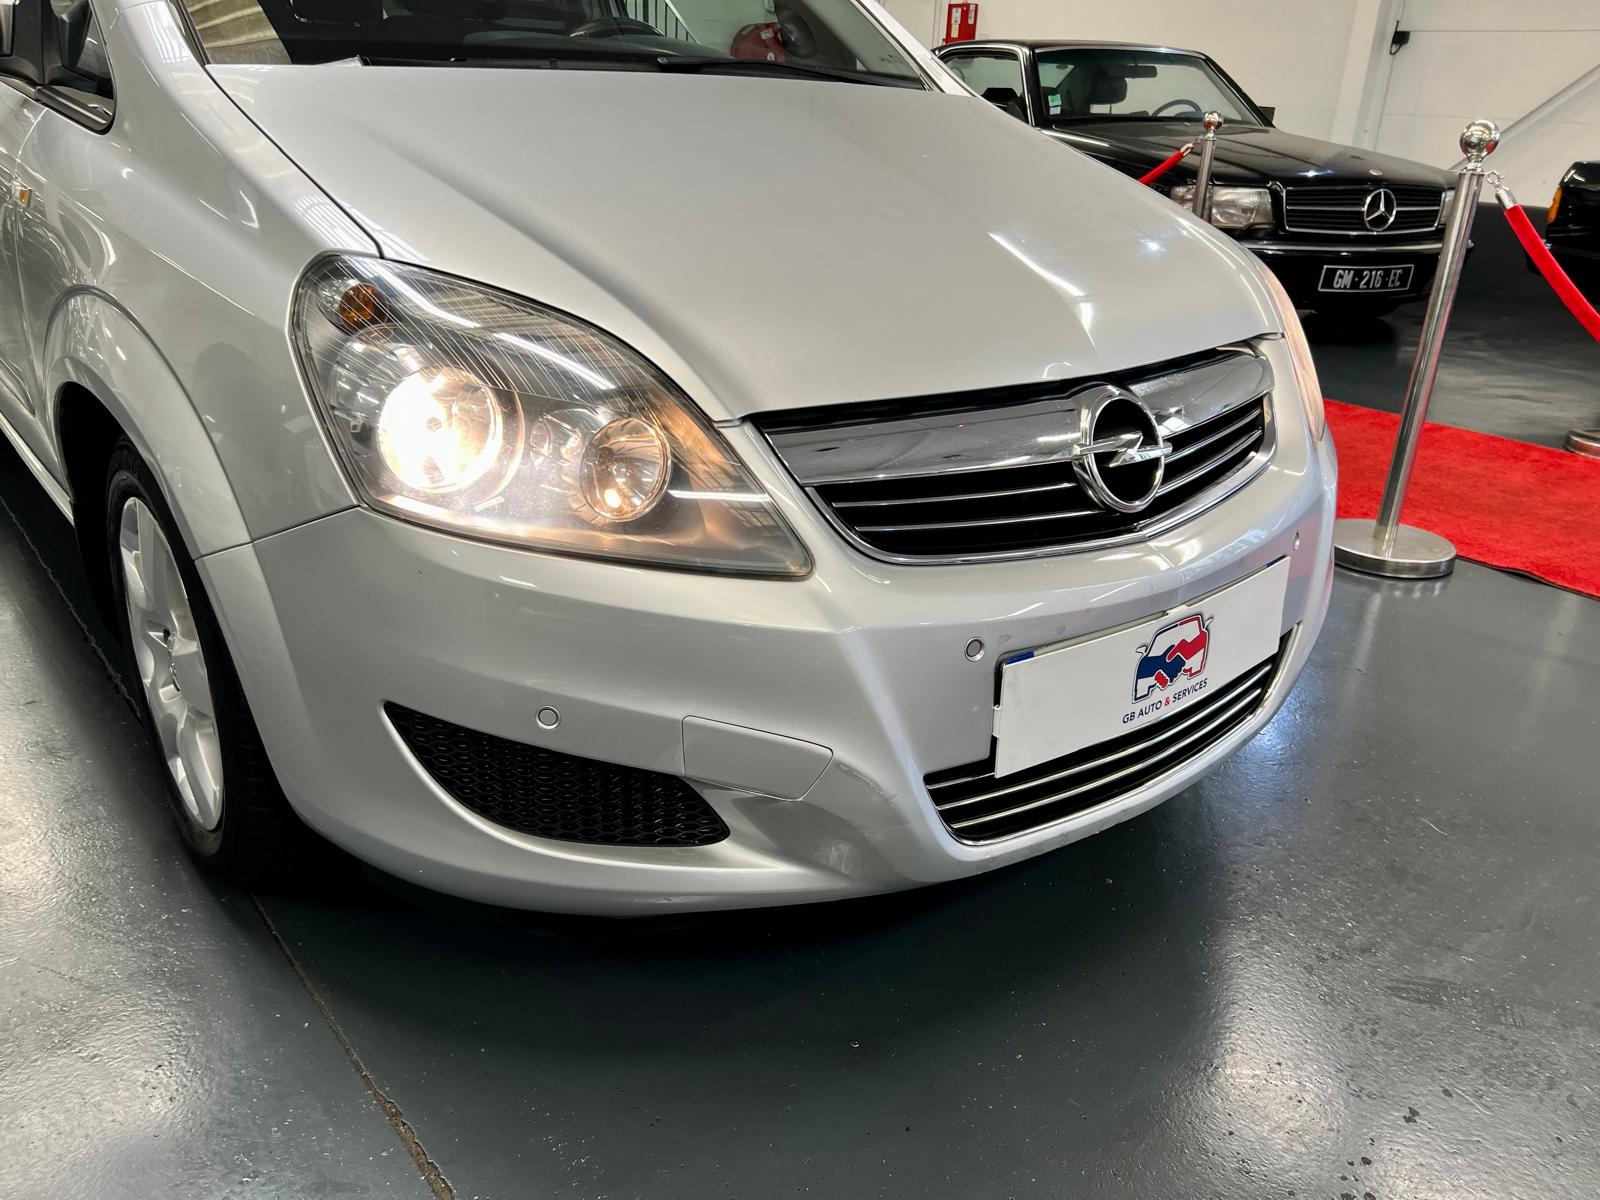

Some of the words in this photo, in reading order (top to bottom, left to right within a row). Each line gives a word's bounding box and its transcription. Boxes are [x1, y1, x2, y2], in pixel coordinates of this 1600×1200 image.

[1122, 712, 1136, 724] GB
[1137, 700, 1163, 718] AUTO
[1164, 696, 1171, 707] &
[1172, 678, 1208, 703] SERVICES
